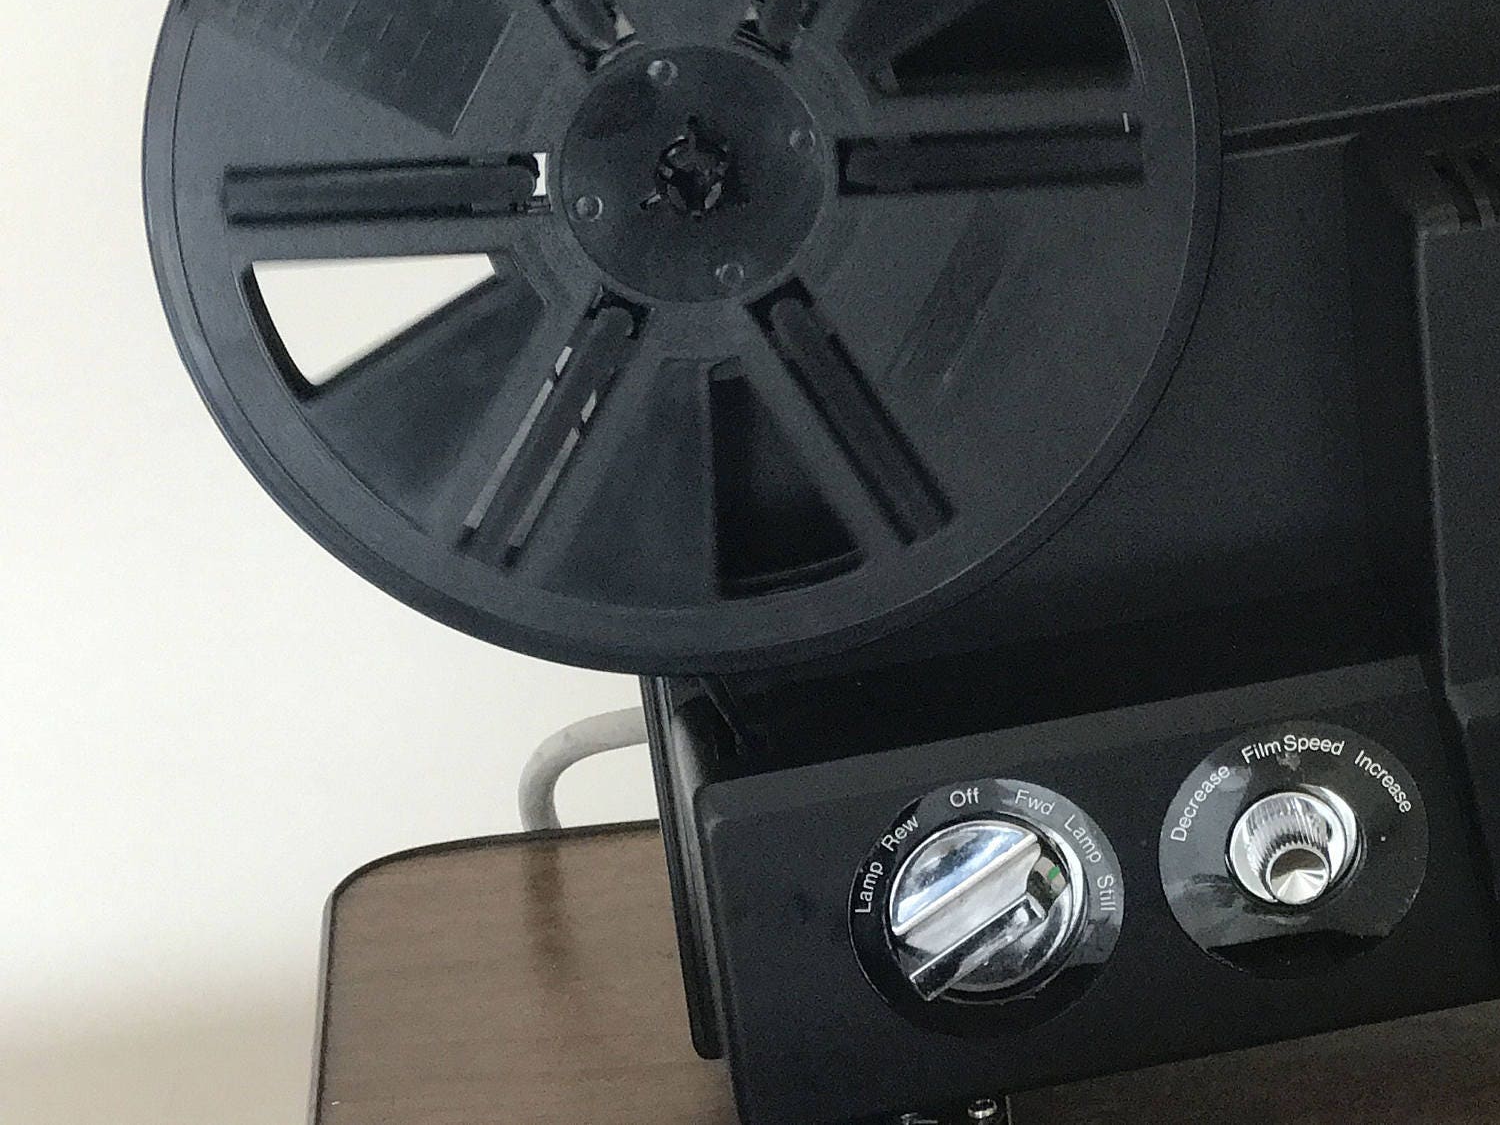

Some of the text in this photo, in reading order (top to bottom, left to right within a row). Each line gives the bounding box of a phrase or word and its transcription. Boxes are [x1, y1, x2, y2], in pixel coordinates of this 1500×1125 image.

[1241, 734, 1345, 764] Film Speed
[950, 787, 980, 808] Off
[1354, 749, 1412, 814] Increase
[1014, 788, 1056, 817] Fwd
[1170, 764, 1231, 843] Decrease
[880, 814, 920, 852] Rew
[1063, 814, 1103, 865] Lamp
[854, 860, 884, 914] Lamp
[1095, 874, 1117, 913] Still
